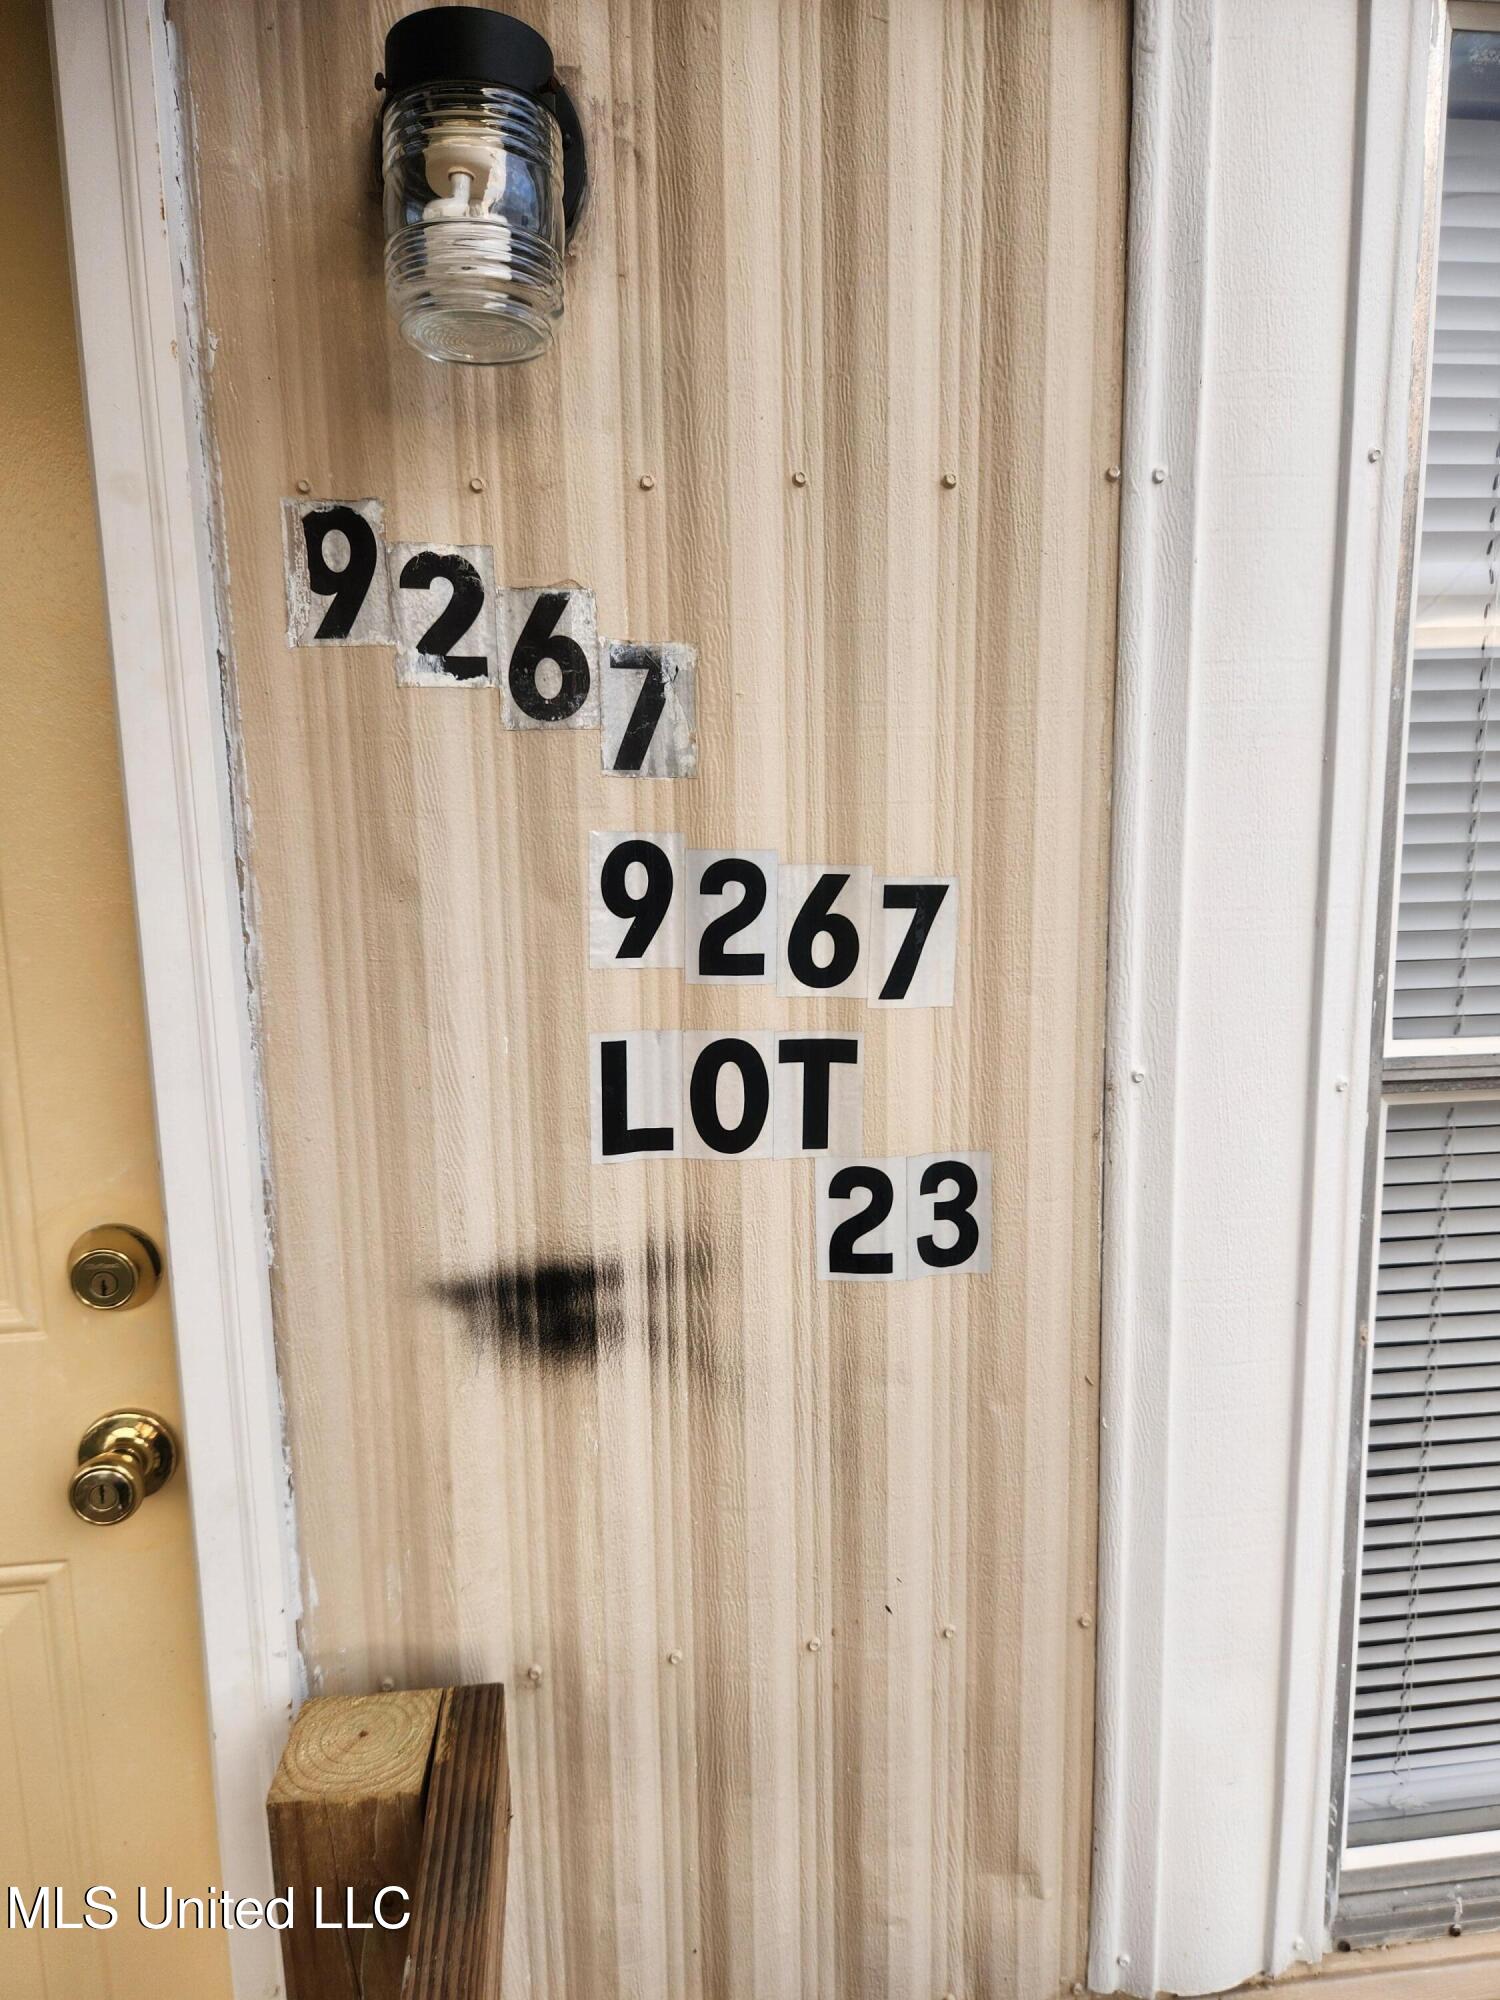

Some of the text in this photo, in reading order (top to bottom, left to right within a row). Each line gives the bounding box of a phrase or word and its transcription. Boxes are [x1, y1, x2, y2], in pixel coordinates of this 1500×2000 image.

[302, 506, 679, 771] 9267
[601, 840, 950, 1000] 9267
[601, 1038, 858, 1156] LOT
[828, 1160, 979, 1274] 23
